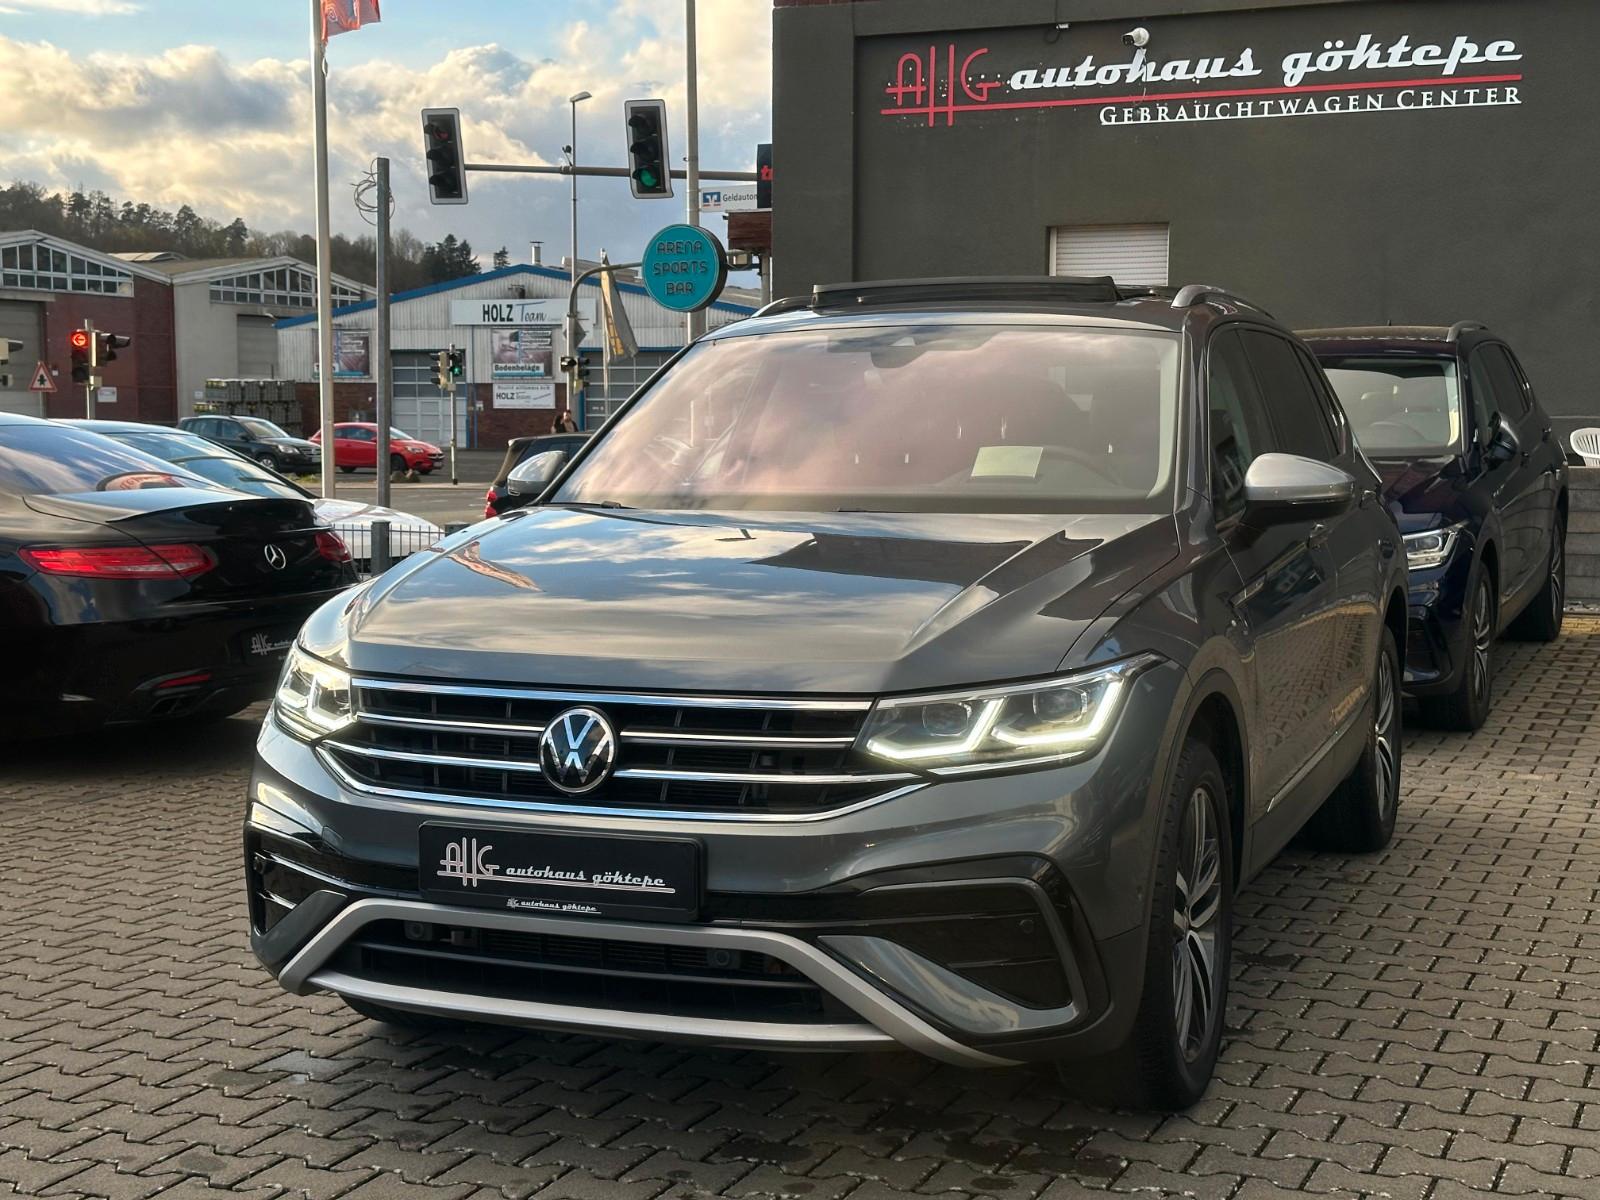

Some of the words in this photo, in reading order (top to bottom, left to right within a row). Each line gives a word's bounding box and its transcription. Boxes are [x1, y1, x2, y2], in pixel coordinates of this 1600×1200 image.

[1010, 47, 1263, 91] autohaus
[1281, 33, 1523, 88] göktepe
[1396, 86, 1522, 109] CENTER
[656, 240, 703, 255] ARENA
[653, 260, 708, 276] SPORTS
[666, 281, 694, 296] BAR
[482, 304, 514, 322] HOLZ
[495, 392, 515, 400] HOLZ
[506, 865, 587, 881] autohaus
[592, 870, 666, 888] göktepe
